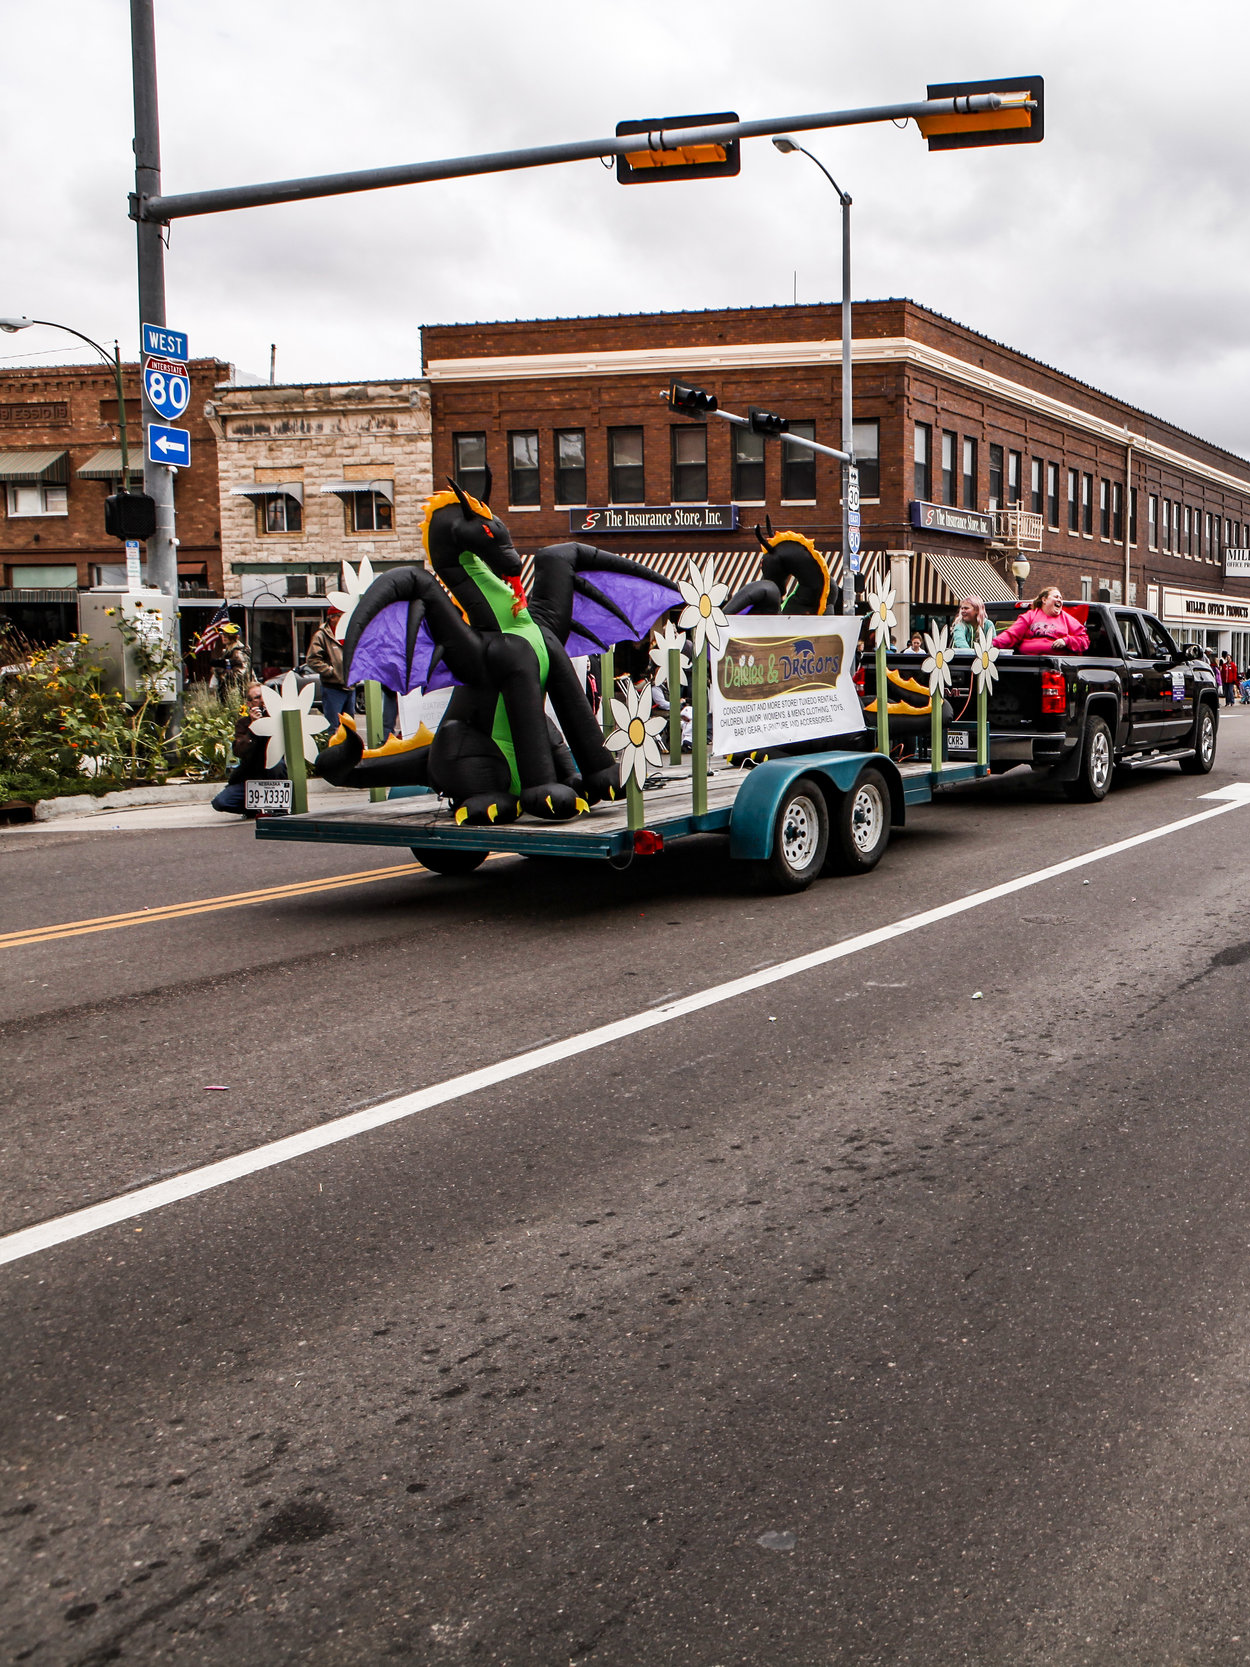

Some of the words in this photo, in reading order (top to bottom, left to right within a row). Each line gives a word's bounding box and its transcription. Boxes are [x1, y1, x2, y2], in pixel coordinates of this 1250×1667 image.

[149, 331, 182, 354] WEST
[151, 361, 183, 375] INTERSTATE
[149, 372, 186, 409] 80
[850, 490, 858, 505] 30
[604, 510, 622, 527] The
[625, 510, 672, 527] Insurance
[674, 509, 703, 527] Store,
[705, 509, 722, 525] Inc.
[936, 509, 945, 526] The
[945, 511, 967, 529] Insurance
[967, 515, 980, 533] Store,
[850, 532, 859, 548] 80
[1185, 600, 1206, 614] MILLER
[1207, 603, 1225, 616] OFFICE
[1226, 605, 1248, 618] PRODUCTS
[724, 655, 764, 688] Daisies
[767, 653, 779, 684] &
[944, 688, 970, 697] MC
[723, 704, 756, 716] CONSIGNMENT
[757, 702, 766, 711] AND
[767, 701, 780, 710] MORE
[799, 696, 817, 705] TUXEDO
[791, 708, 806, 717] MEN'S
[734, 727, 747, 737] BABY
[763, 720, 789, 732] FURNITURE
[789, 719, 799, 728] AND
[249, 790, 289, 804] 39-X3330
